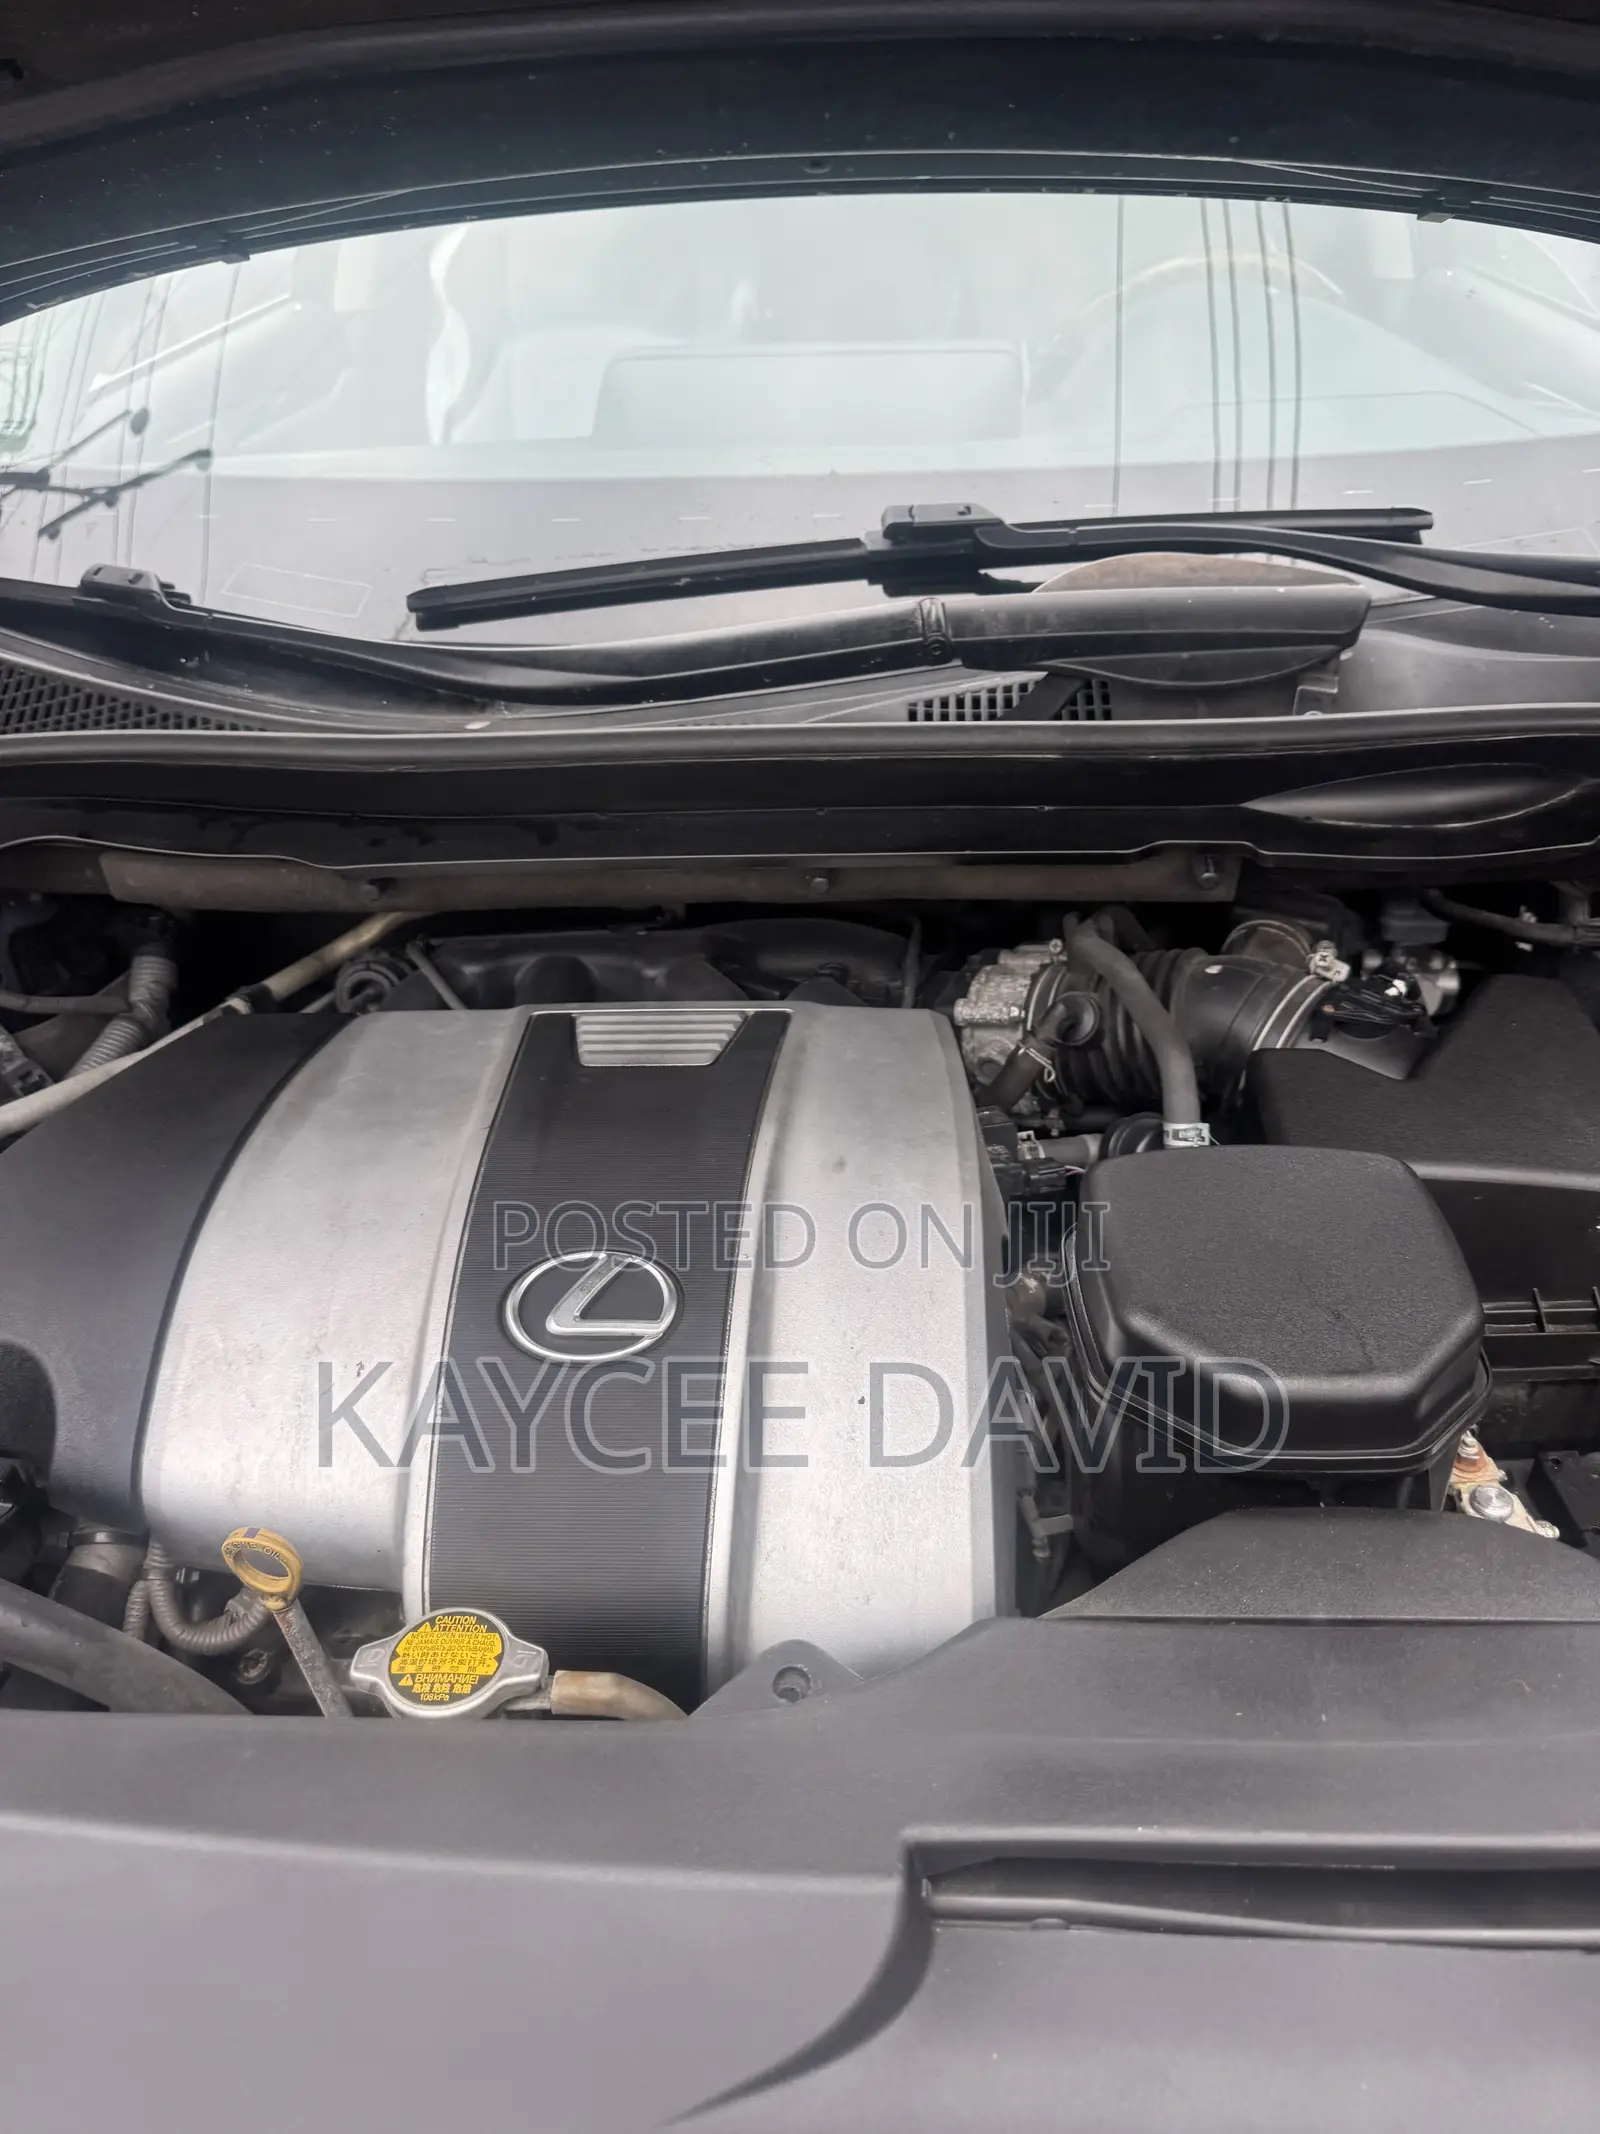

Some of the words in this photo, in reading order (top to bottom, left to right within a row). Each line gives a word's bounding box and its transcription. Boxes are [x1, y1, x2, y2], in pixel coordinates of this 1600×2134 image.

[263, 1546, 281, 1560] OIL
[435, 1616, 477, 1624] CAUTION
[432, 1624, 487, 1632] ATTENTION
[457, 1632, 480, 1640] WHEN
[414, 1638, 439, 1646] JAMAIS
[440, 1638, 465, 1646] OUVRIR
[415, 1674, 479, 1684] ВНИМАНИЕ!
